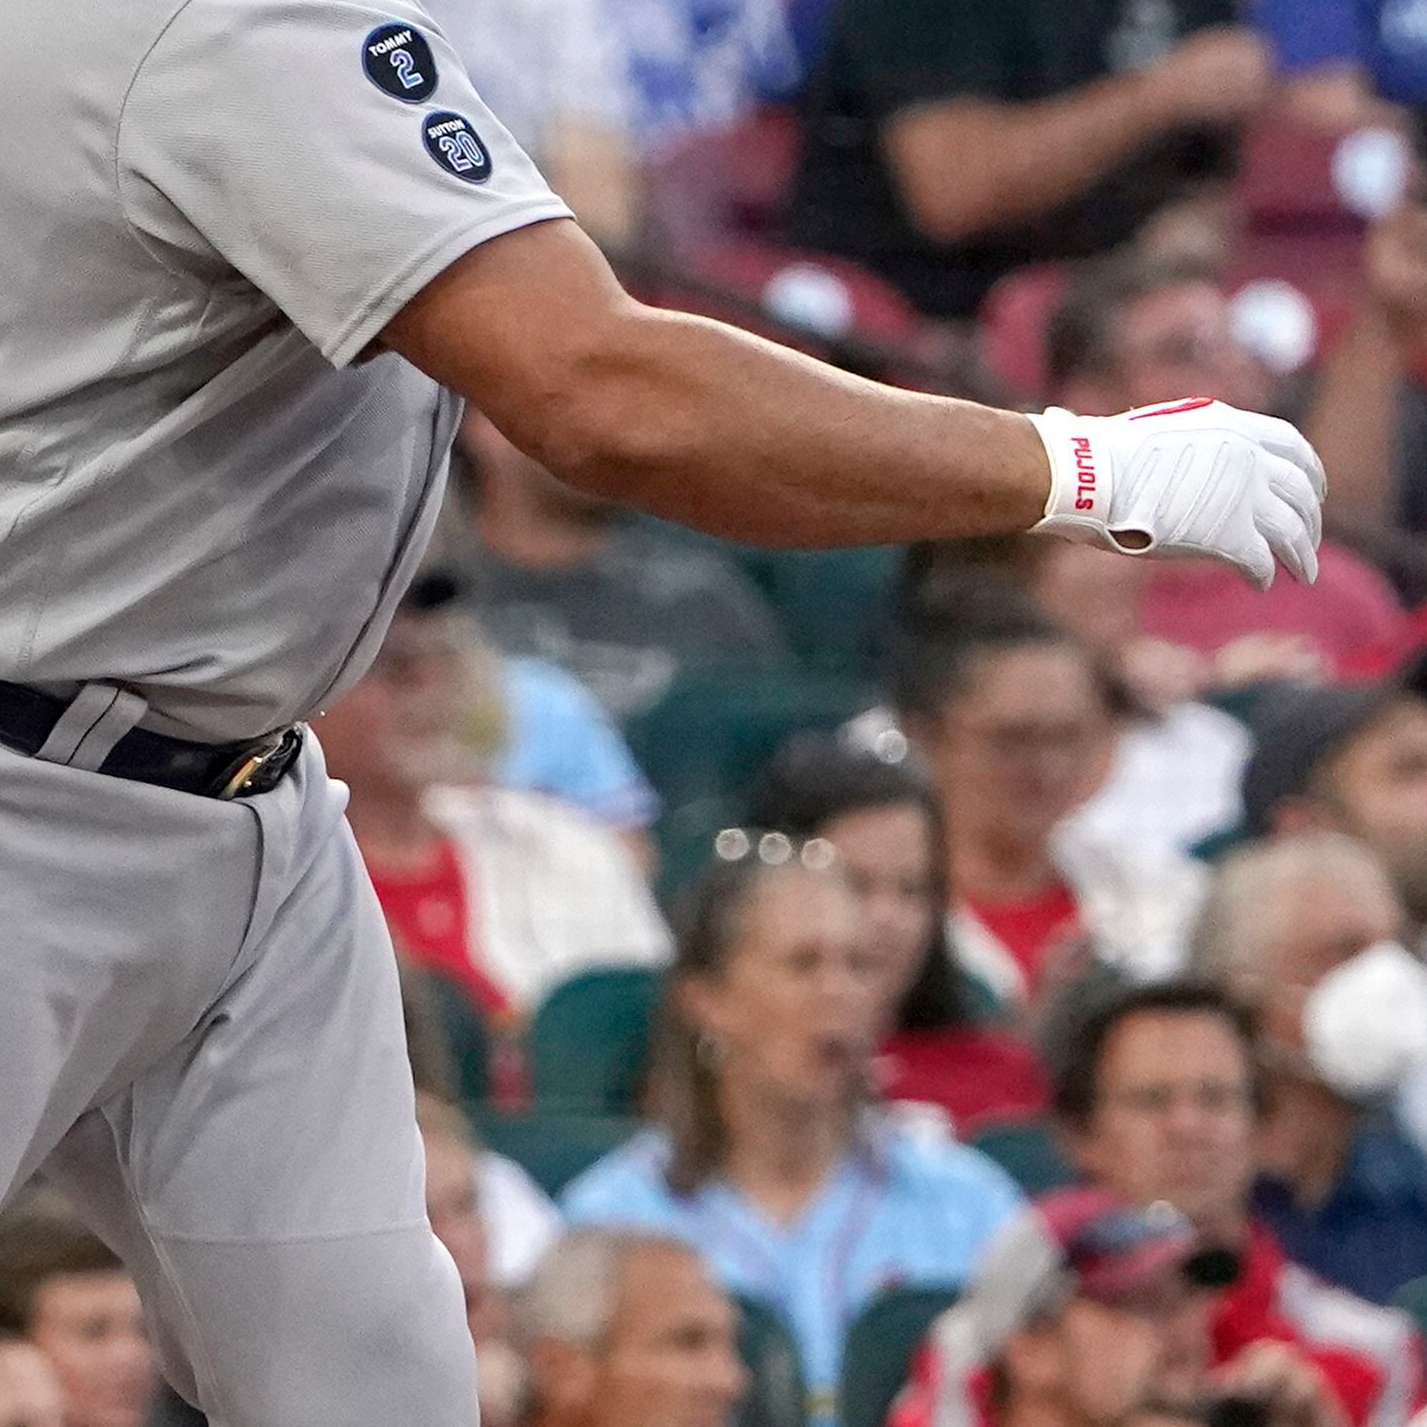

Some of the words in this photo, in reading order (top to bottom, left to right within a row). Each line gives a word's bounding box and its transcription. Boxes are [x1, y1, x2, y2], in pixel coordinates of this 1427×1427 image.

[368, 30, 413, 57] TOMMY
[389, 48, 425, 89] 2
[427, 119, 466, 139] SUTTON
[438, 130, 485, 172] 20
[1070, 437, 1096, 510] PUJOLS
